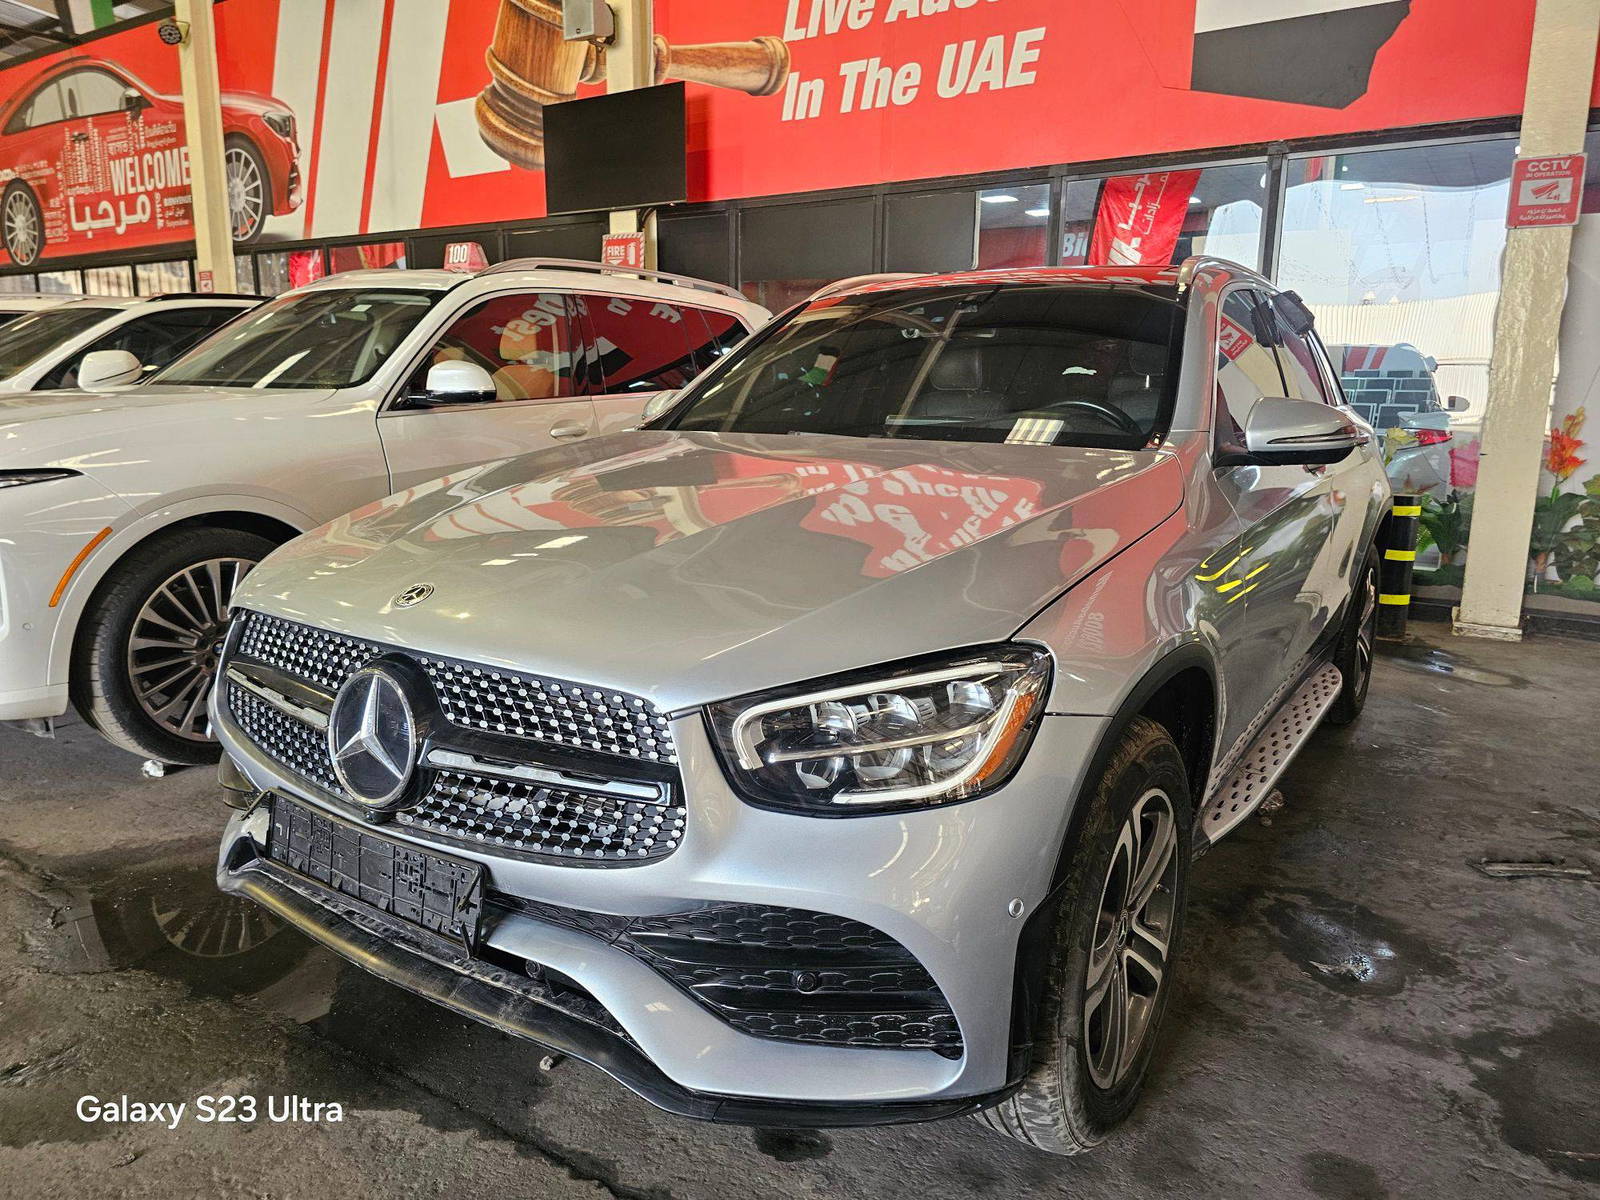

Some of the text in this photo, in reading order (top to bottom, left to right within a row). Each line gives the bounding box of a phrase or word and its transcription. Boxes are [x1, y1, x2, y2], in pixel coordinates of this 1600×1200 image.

[781, 27, 1047, 121] In The UAE
[110, 146, 192, 196] WELCOME
[1527, 160, 1571, 172] CCTV
[69, 194, 152, 240] مرحبا
[449, 244, 468, 264] 100
[606, 245, 625, 257] FIRE
